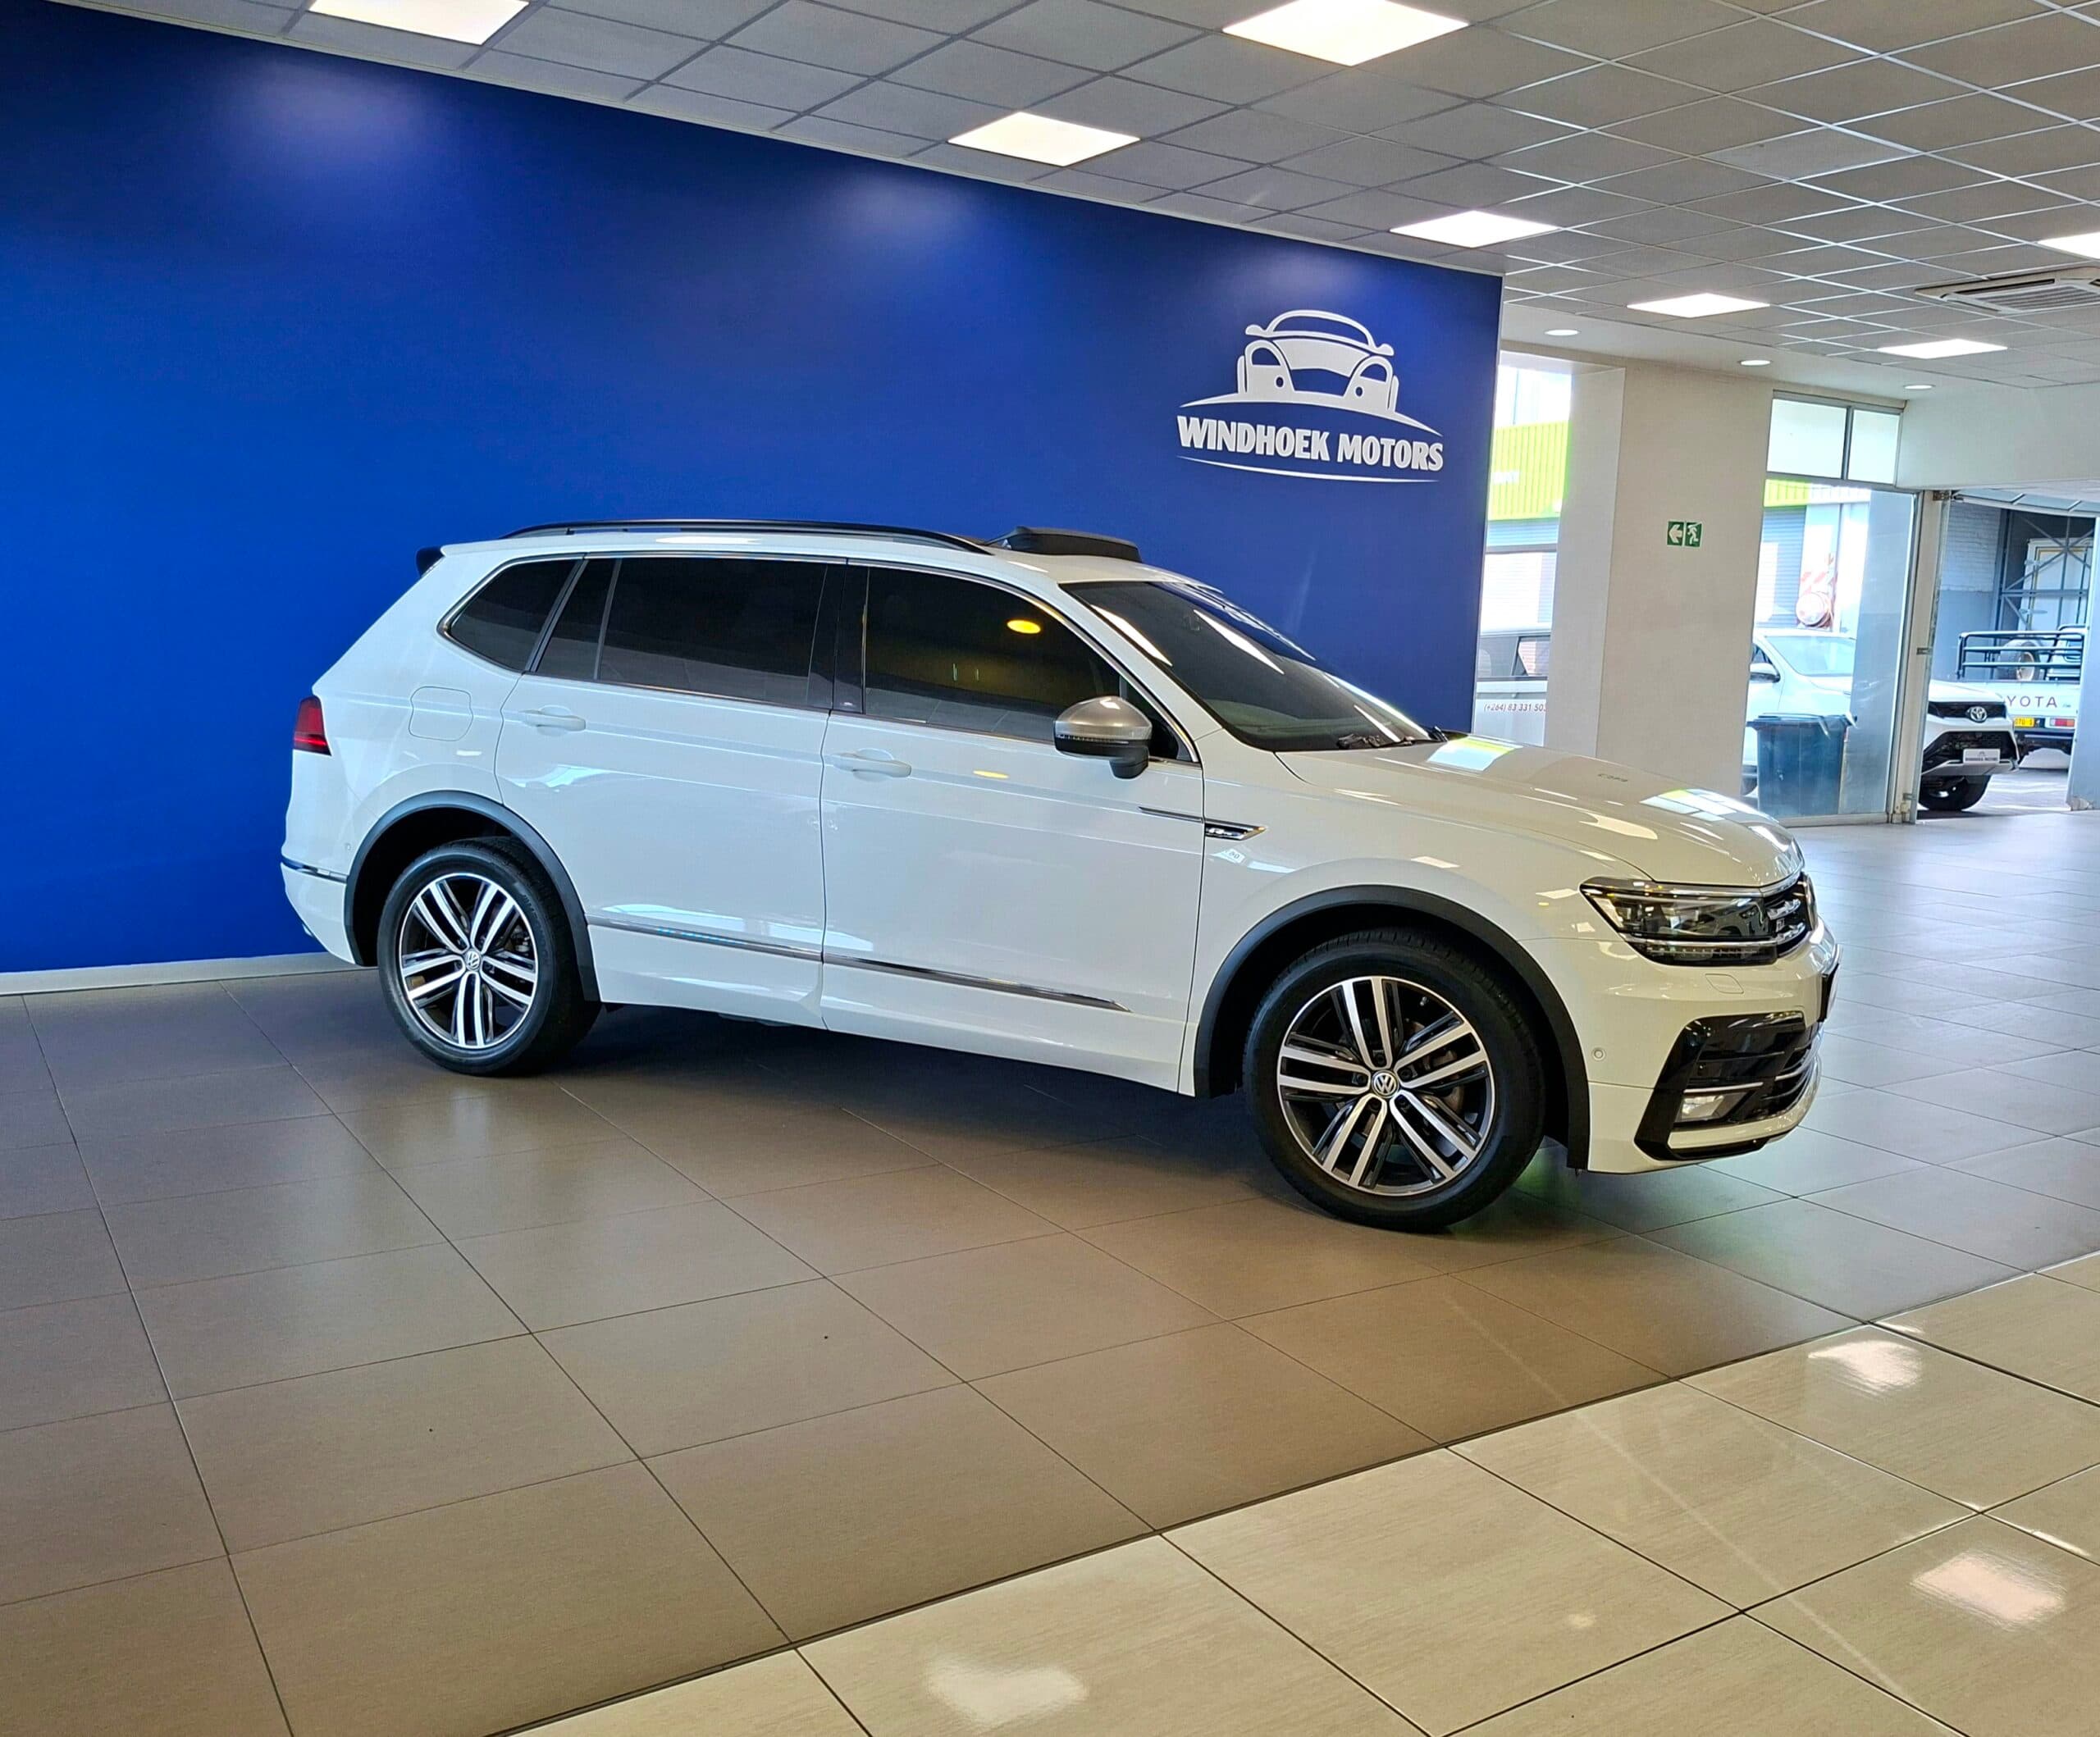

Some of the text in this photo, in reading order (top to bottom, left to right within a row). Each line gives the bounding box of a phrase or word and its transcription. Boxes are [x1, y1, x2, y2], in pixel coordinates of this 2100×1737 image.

[1177, 415, 1444, 472] WINDHOEK MOTORS
[2006, 695, 2057, 708] YOTA
[1374, 1073, 1397, 1096] VW
